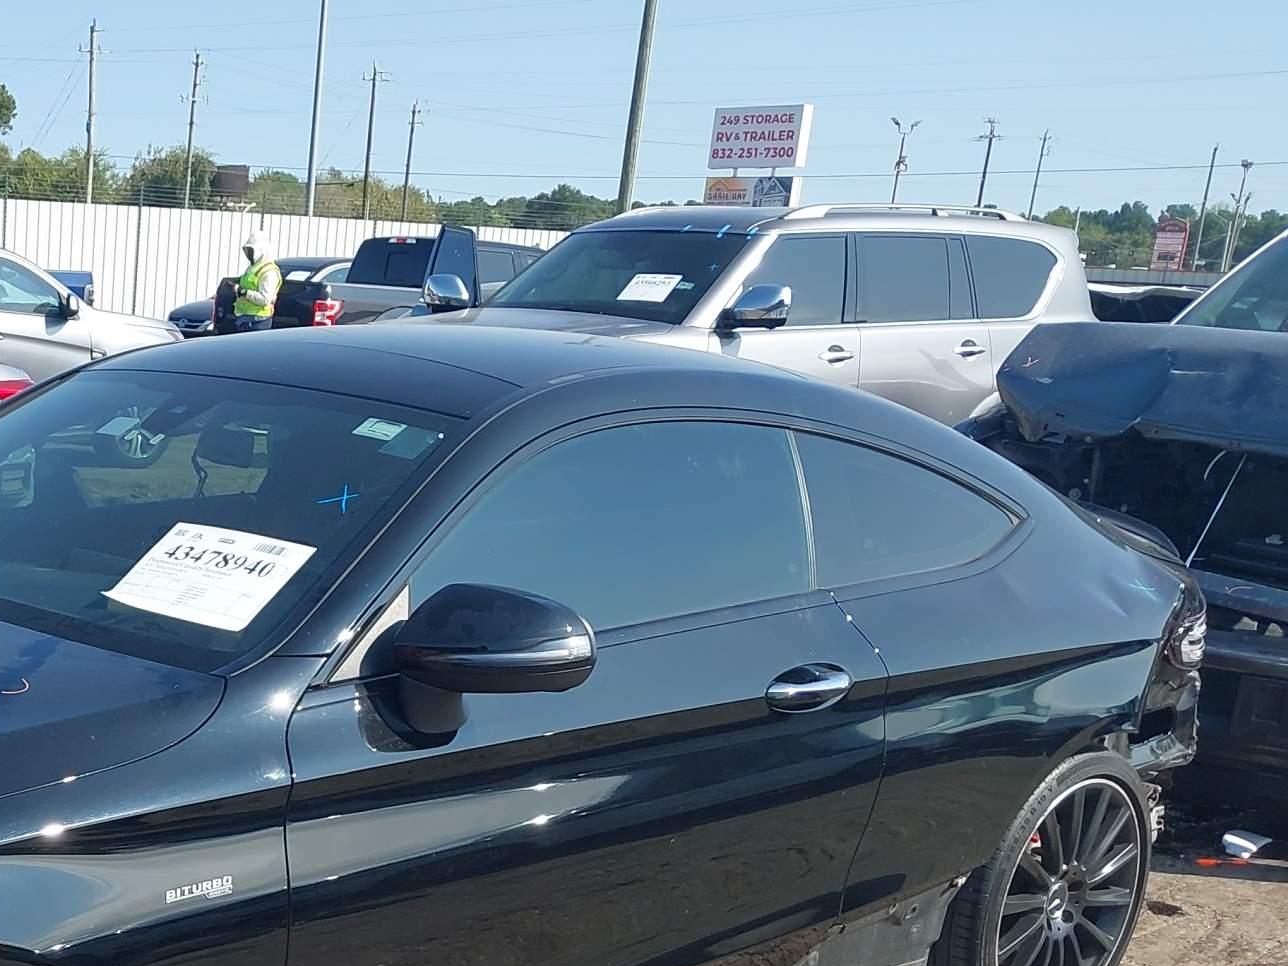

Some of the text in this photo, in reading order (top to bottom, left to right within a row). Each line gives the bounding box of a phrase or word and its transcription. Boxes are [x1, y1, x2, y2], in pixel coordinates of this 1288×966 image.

[720, 113, 795, 126] 249 STORAGE
[716, 130, 795, 142] RV & TRAILER
[711, 147, 794, 159] 832-251-7300
[164, 544, 276, 578] 43478940
[165, 875, 233, 900] BITURBO
